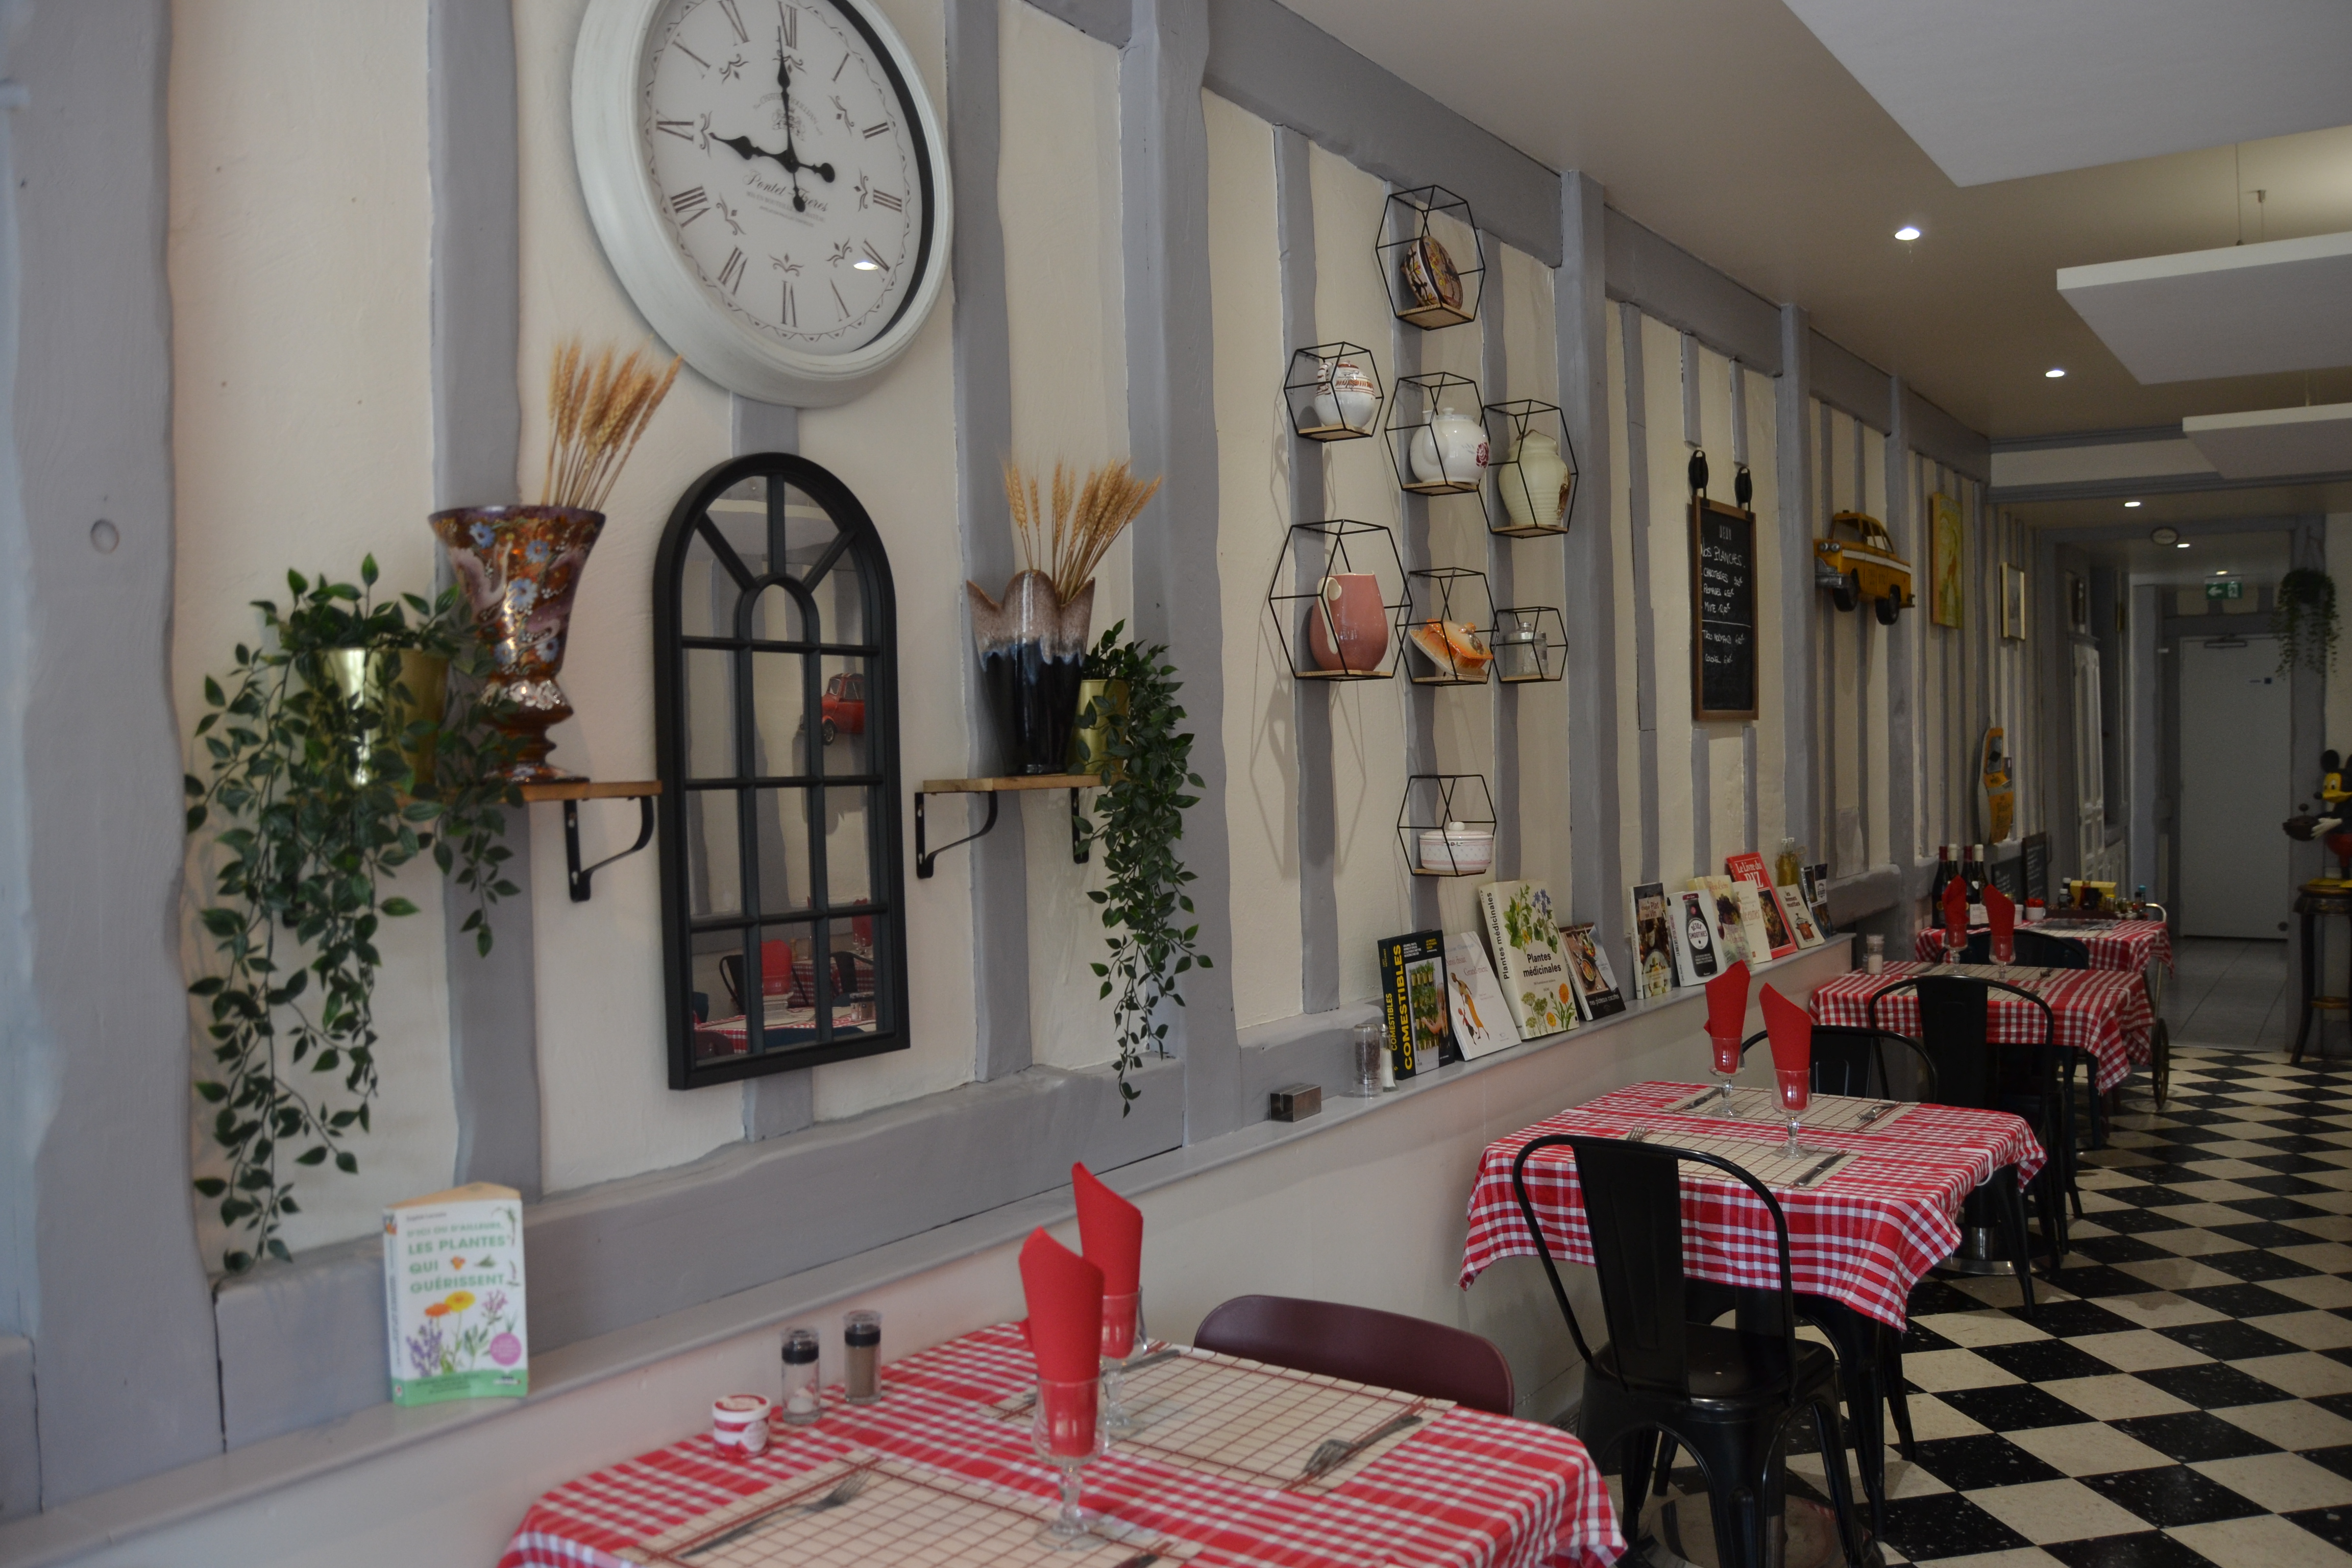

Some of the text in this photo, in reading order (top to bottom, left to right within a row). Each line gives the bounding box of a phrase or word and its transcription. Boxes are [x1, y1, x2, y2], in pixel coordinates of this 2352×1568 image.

[1741, 862, 1755, 873] Livre
[1487, 892, 1510, 979] Plantes médicinales
[1527, 953, 1552, 964] Plantes
[1523, 963, 1561, 977] médicinales
[1393, 944, 1413, 1070] COMESTIBLES
[1385, 992, 1398, 1051] COMESTIBLES
[408, 1235, 506, 1256] LES PLANTES
[409, 1259, 438, 1275] QUI
[410, 1273, 504, 1294] GUÉRISSENT
